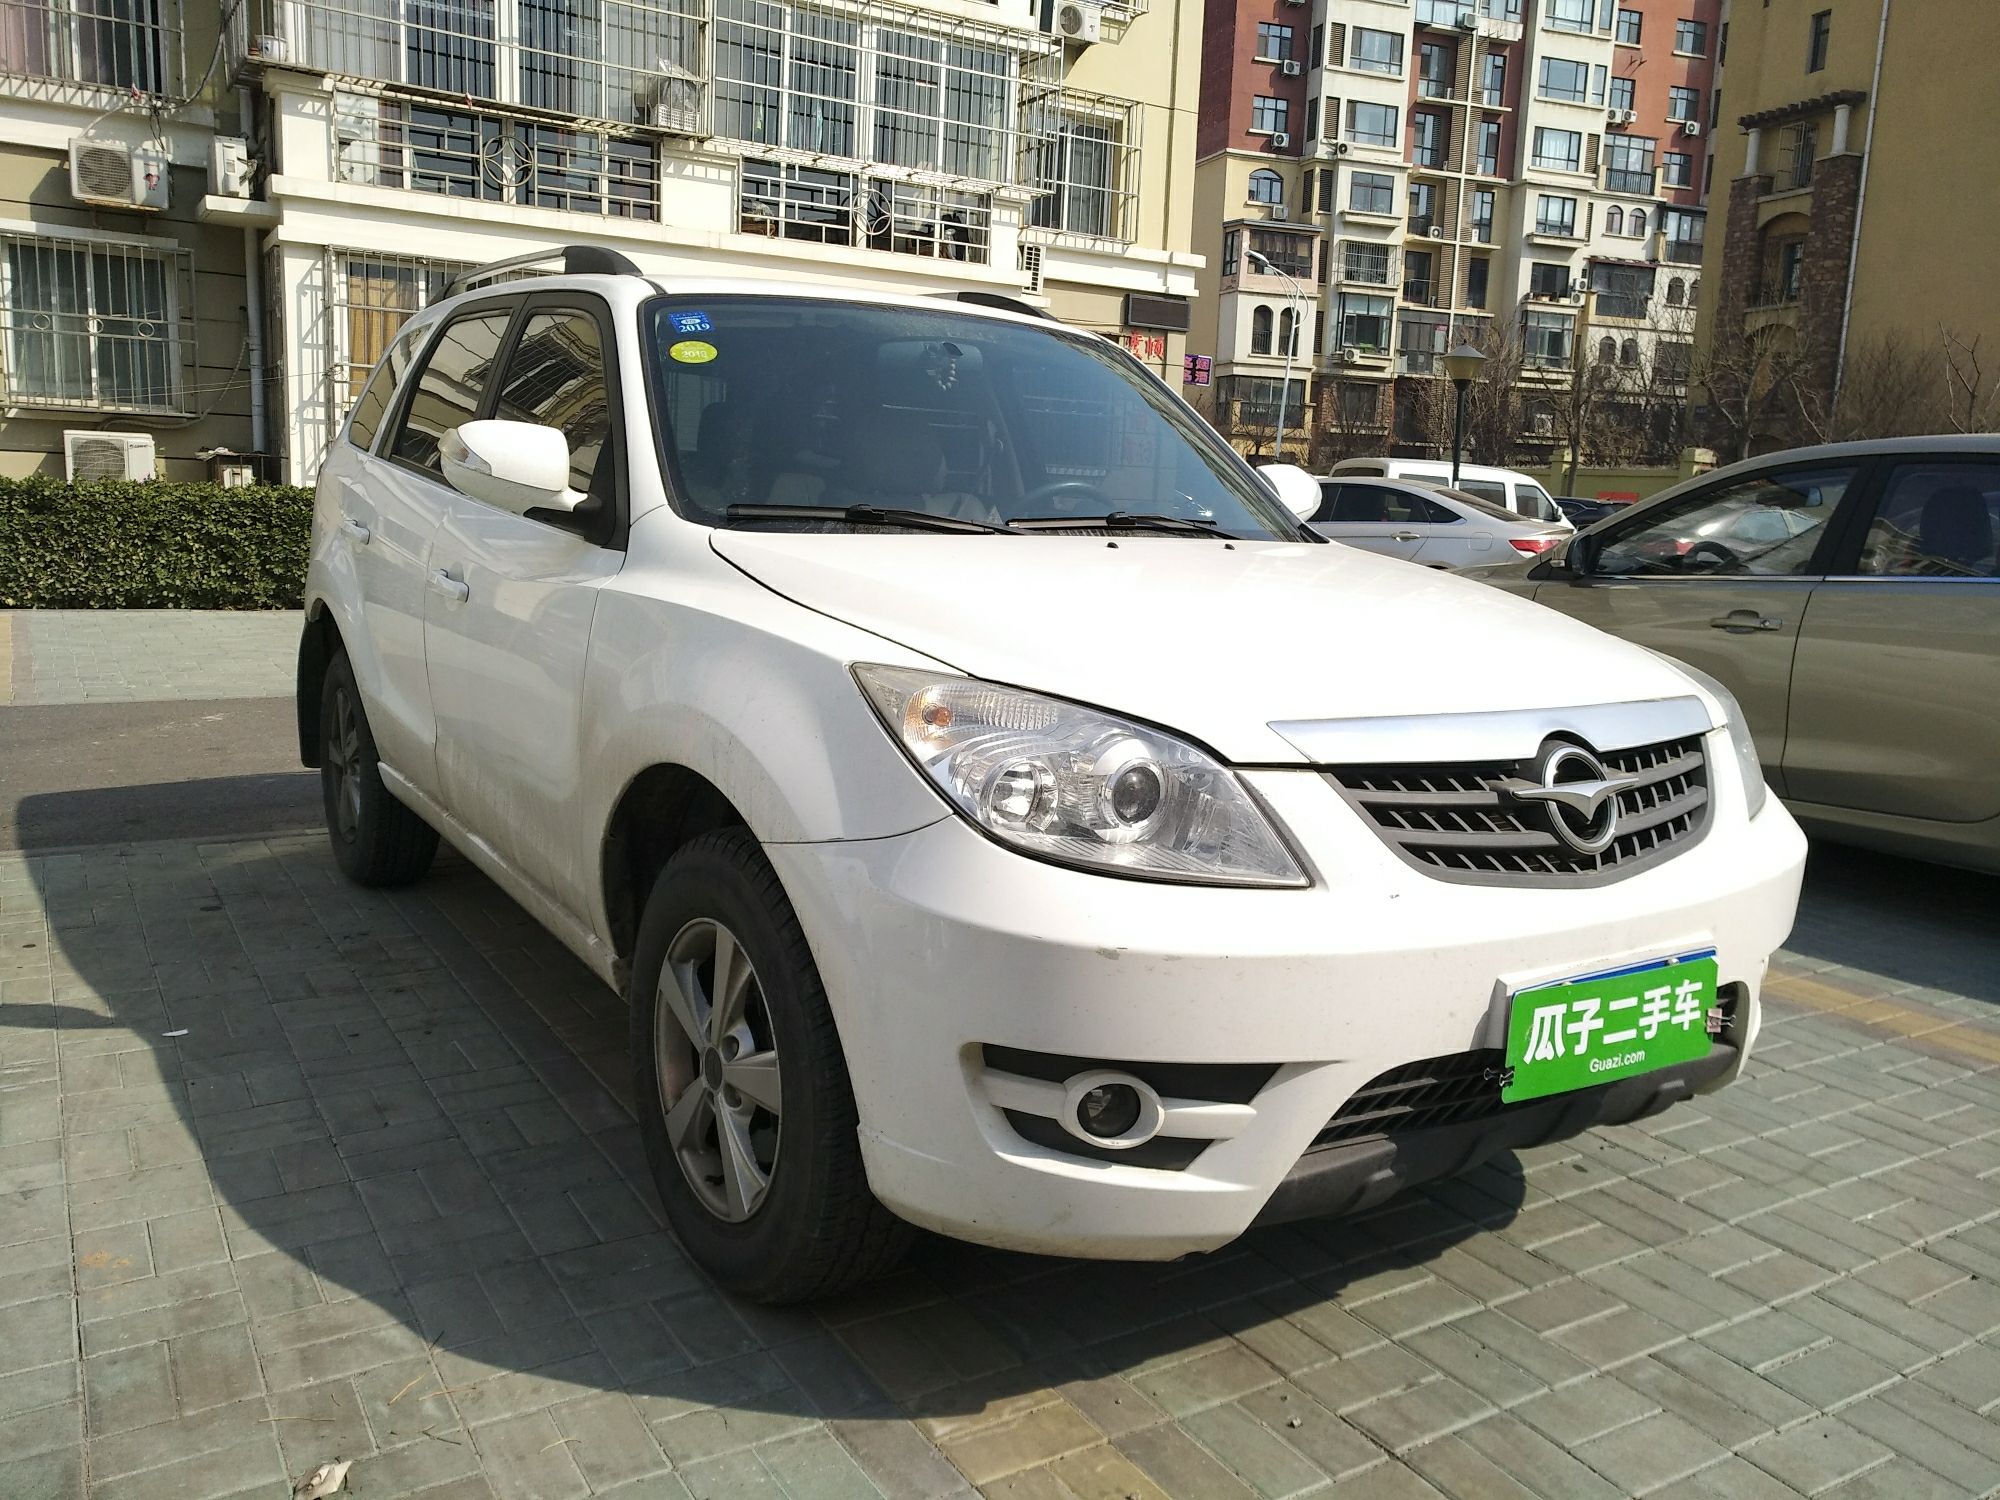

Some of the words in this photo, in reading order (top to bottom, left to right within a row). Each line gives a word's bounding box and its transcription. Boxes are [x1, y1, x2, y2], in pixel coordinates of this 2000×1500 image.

[679, 323, 710, 333] 2019
[1523, 979, 1703, 1065] 瓜子二手车
[1589, 1050, 1645, 1073] Guazi.com
